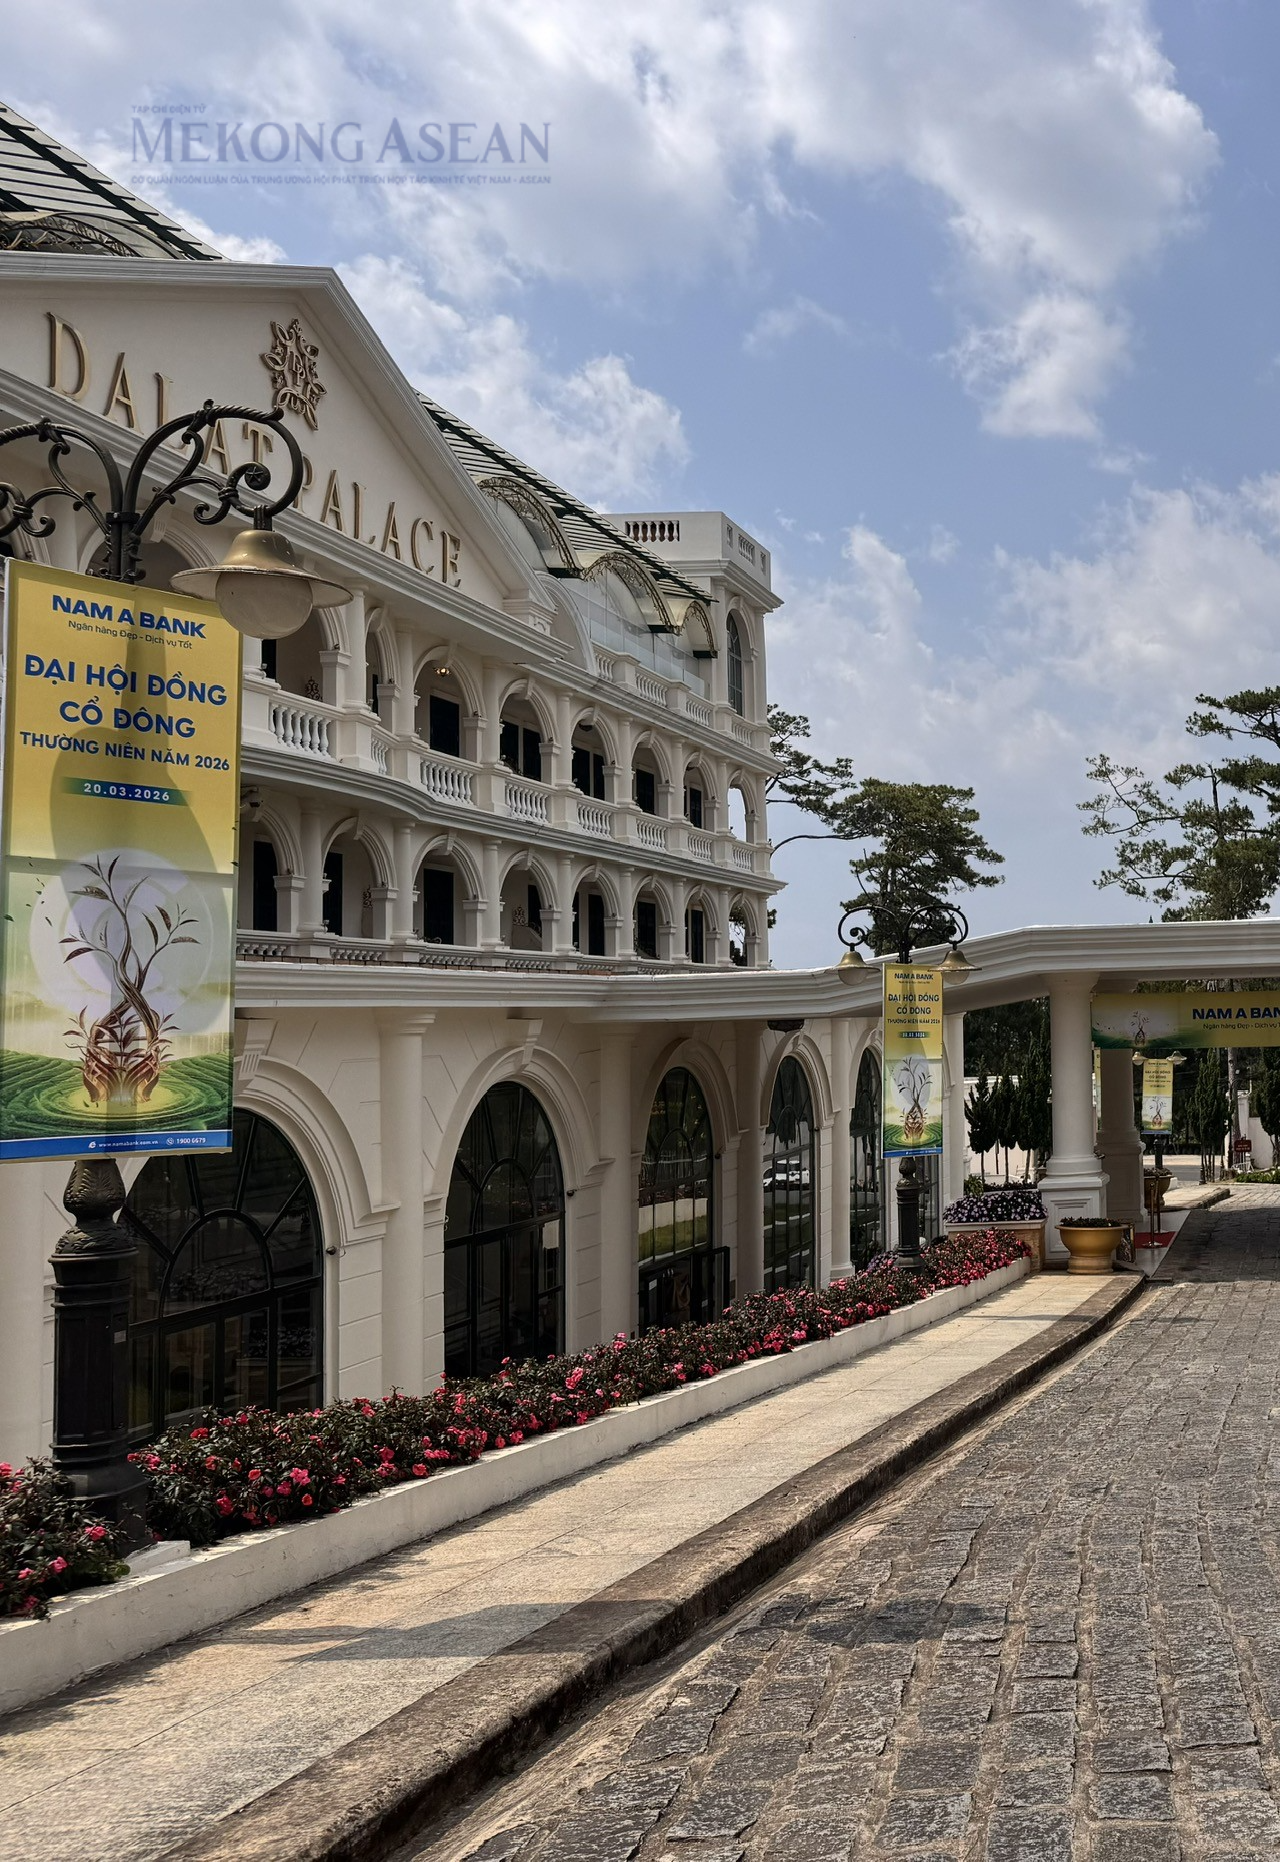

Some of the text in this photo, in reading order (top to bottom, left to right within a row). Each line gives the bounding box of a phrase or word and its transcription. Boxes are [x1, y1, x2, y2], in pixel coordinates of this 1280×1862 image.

[293, 453, 462, 588] PALACE
[52, 594, 207, 639] NAM A BANK
[68, 620, 93, 632] Ngân
[95, 625, 118, 637] hàng
[120, 630, 138, 641] Đẹp
[145, 635, 165, 644] Dịch
[179, 640, 193, 649] Tốt
[24, 654, 228, 706] ĐẠI HỘI ĐỒNG
[59, 695, 196, 738] CỔ ĐÔNG
[20, 731, 230, 771] THƯỜNG NIÊN NĂM 2026
[83, 782, 170, 801] 20.03.2026
[1192, 1008, 1232, 1019] NAM
[1235, 1008, 1247, 1019] A
[191, 1136, 206, 1144] 6679
